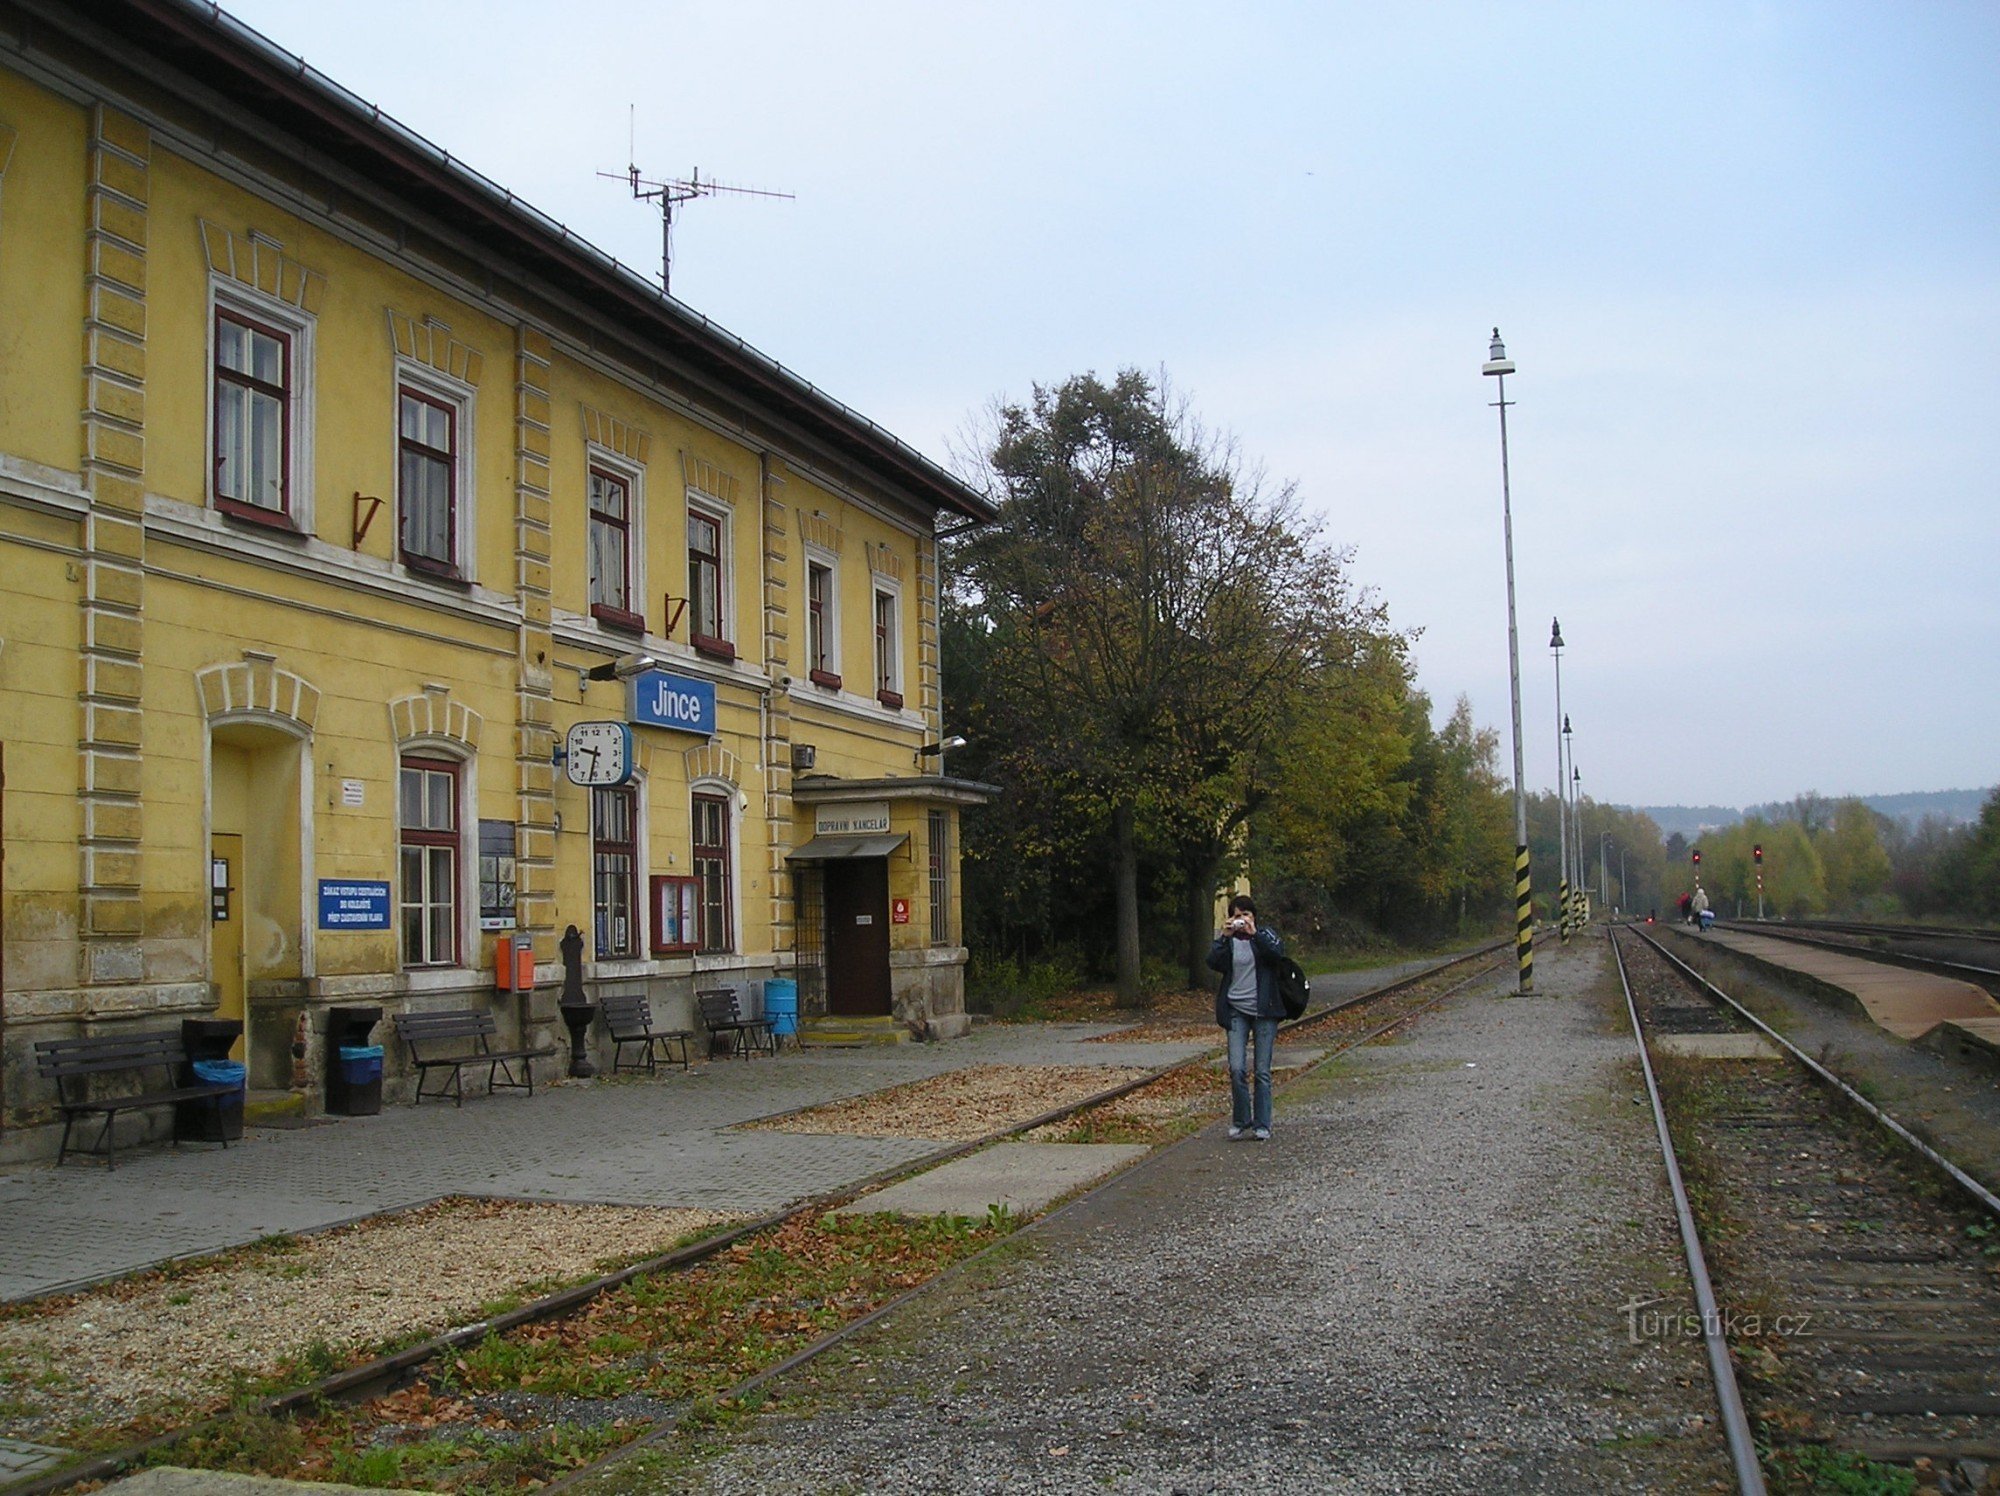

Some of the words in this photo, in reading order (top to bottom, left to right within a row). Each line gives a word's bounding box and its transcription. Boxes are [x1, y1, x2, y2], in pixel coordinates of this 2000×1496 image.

[652, 680, 701, 723] Jince
[323, 884, 340, 896] ZÁKAZ
[340, 886, 358, 896] VSTUPU
[339, 900, 347, 909] DO
[327, 911, 341, 922] PŘED
[368, 913, 383, 922] VLAKU
